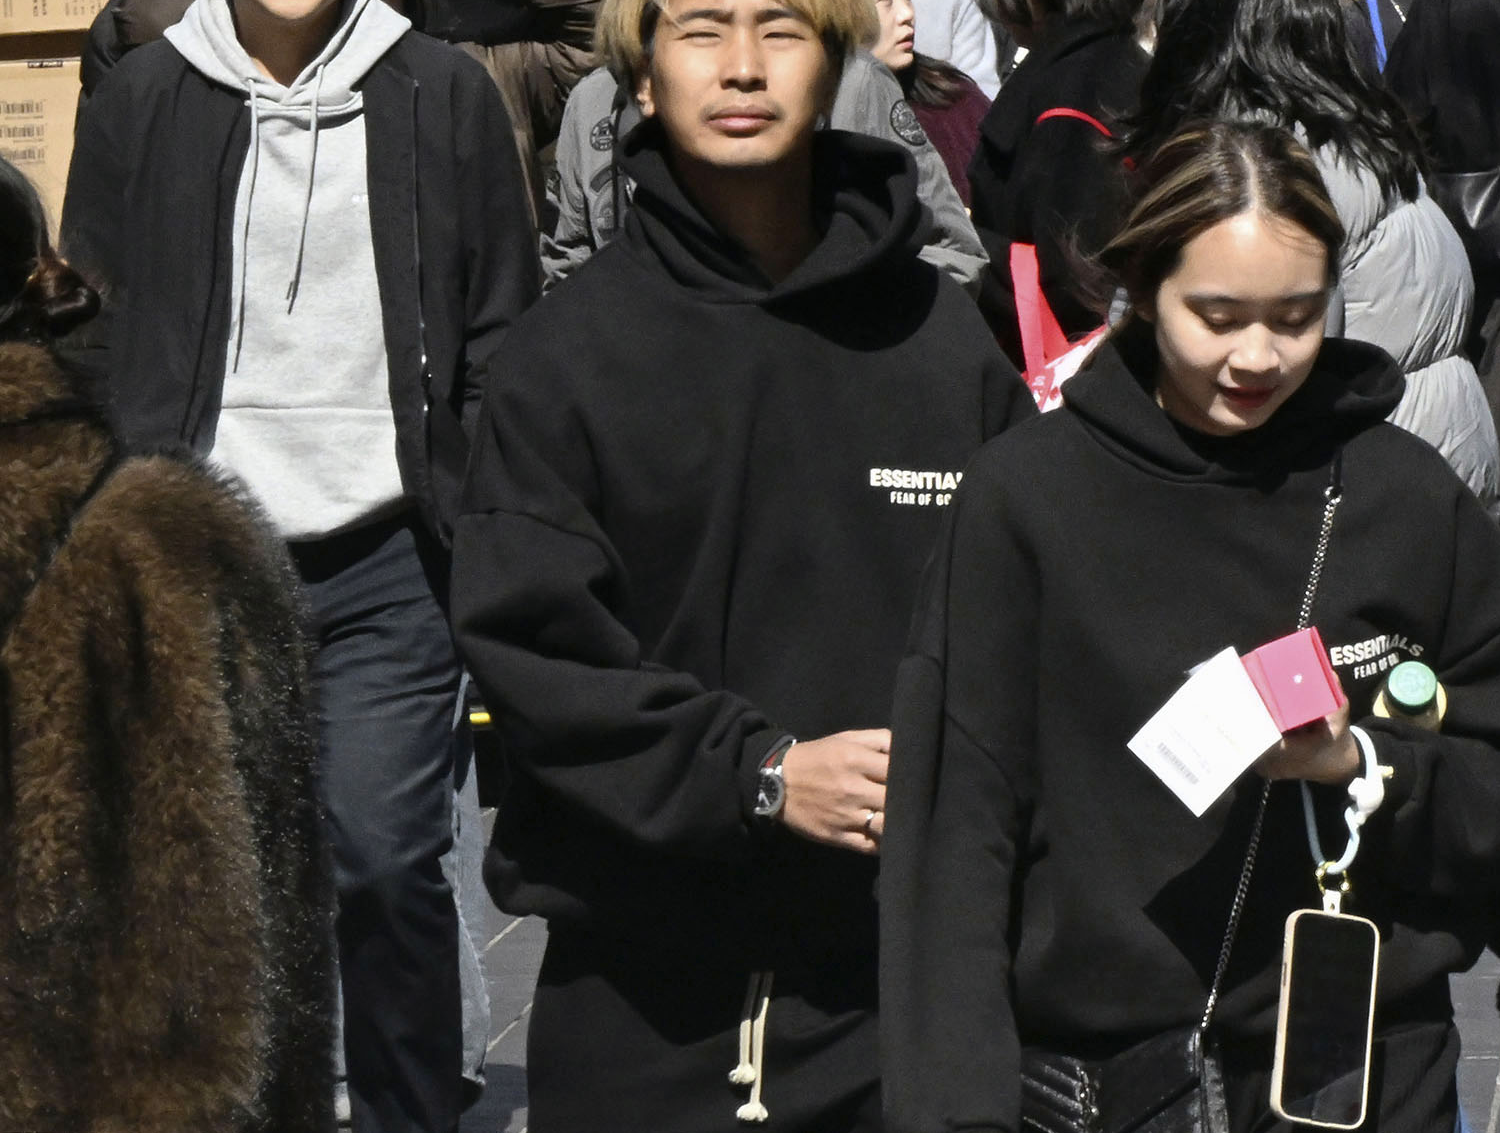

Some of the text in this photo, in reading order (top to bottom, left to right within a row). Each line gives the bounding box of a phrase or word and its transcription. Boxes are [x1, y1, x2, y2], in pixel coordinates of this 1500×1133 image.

[890, 491, 915, 504] FEAR
[917, 493, 932, 505] OF
[1329, 634, 1425, 667] ESSENTIALS
[1353, 661, 1378, 680] FEAR
